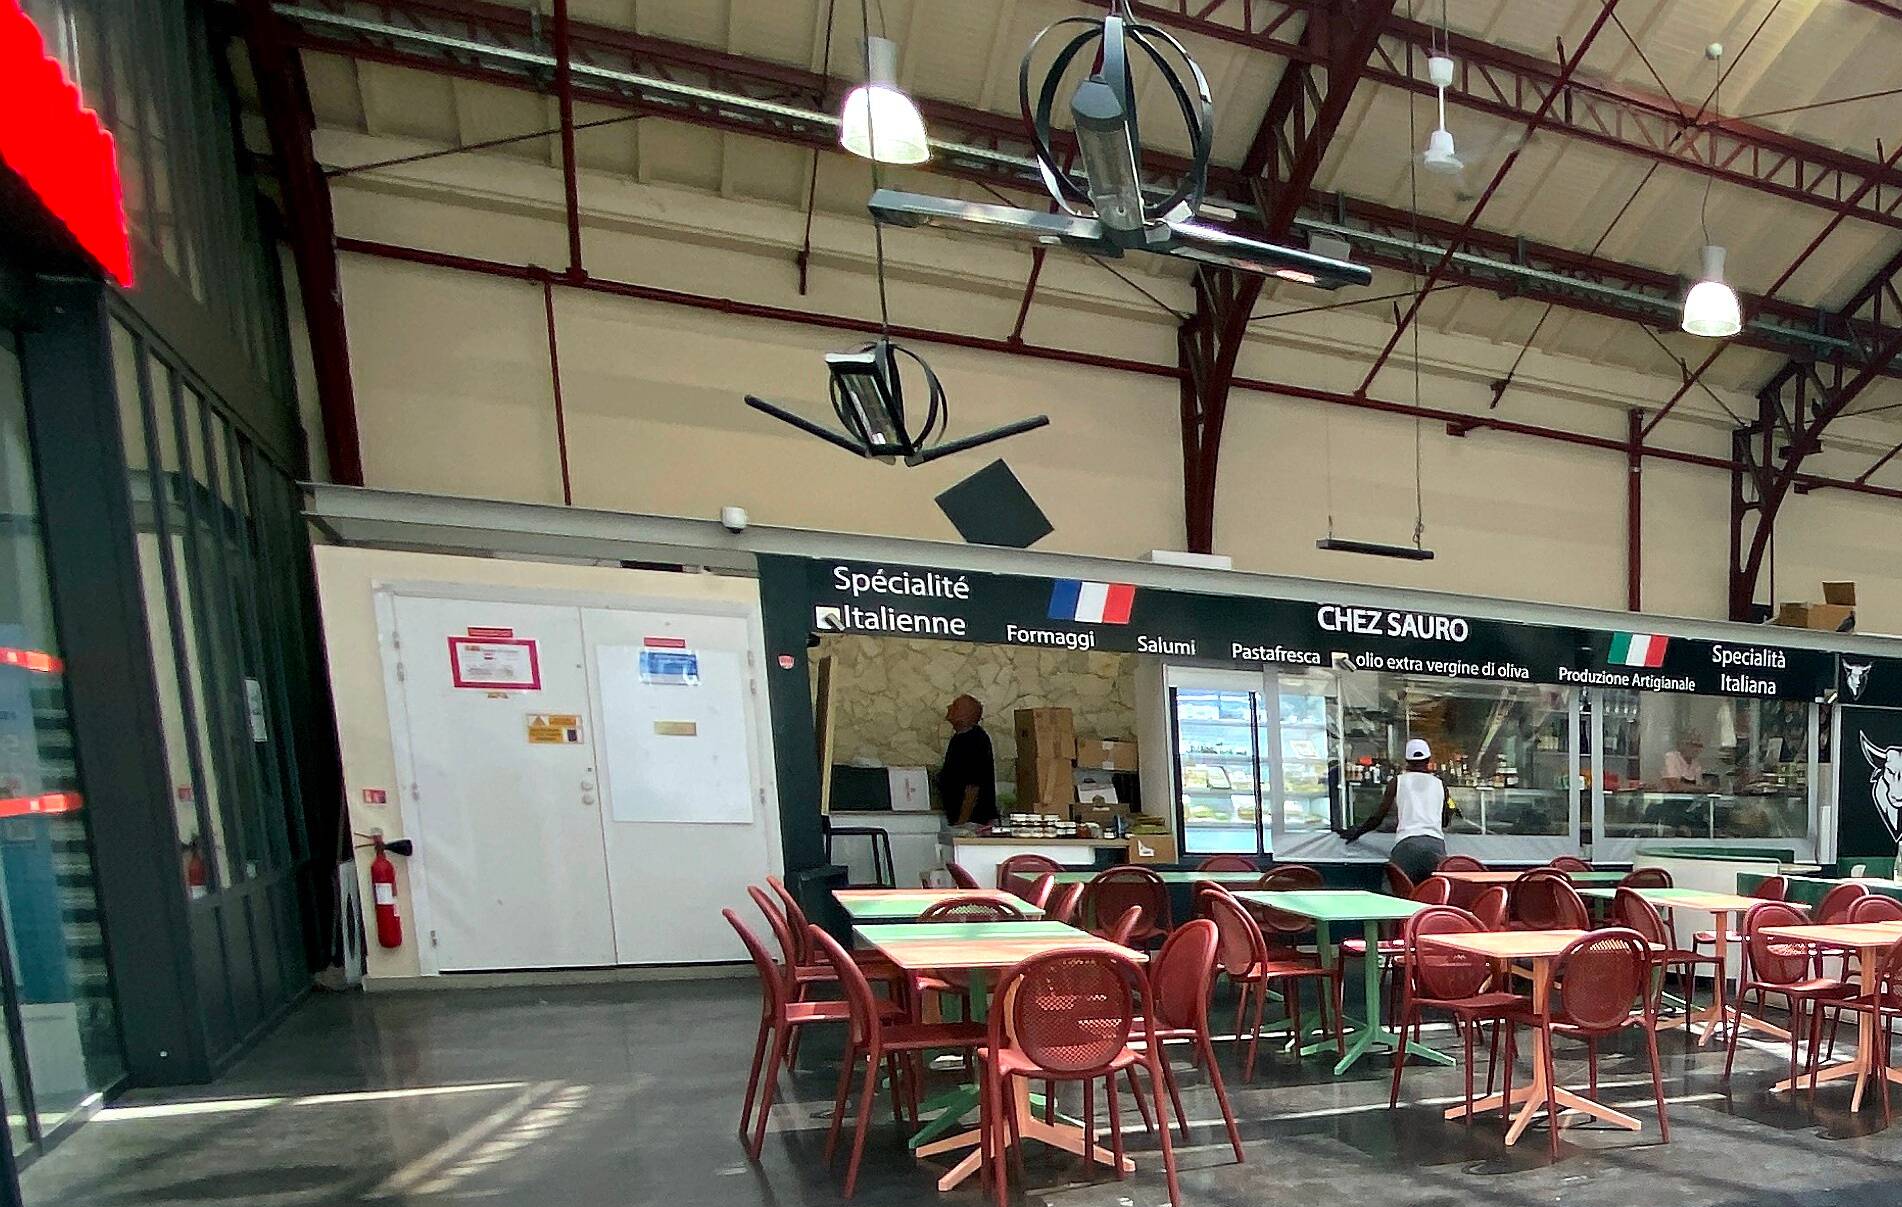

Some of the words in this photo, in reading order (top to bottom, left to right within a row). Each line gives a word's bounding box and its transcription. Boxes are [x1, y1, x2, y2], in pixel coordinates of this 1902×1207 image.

[833, 566, 970, 599] Spécialité
[843, 604, 966, 636] Italienne
[1317, 605, 1382, 635] CHEZ
[1387, 614, 1469, 642] SAURO
[1006, 625, 1095, 650] Formaggi
[1137, 636, 1196, 656] Salumi
[1356, 654, 1383, 669] olio
[1387, 657, 1423, 672] extra
[1426, 659, 1479, 678] vergine
[1482, 662, 1495, 676] di
[1497, 663, 1530, 679] oliva
[1712, 645, 1786, 669] Specialità
[1558, 667, 1629, 687] Produzione
[1632, 674, 1696, 692] Artigianale
[1721, 674, 1777, 695] Italiana
